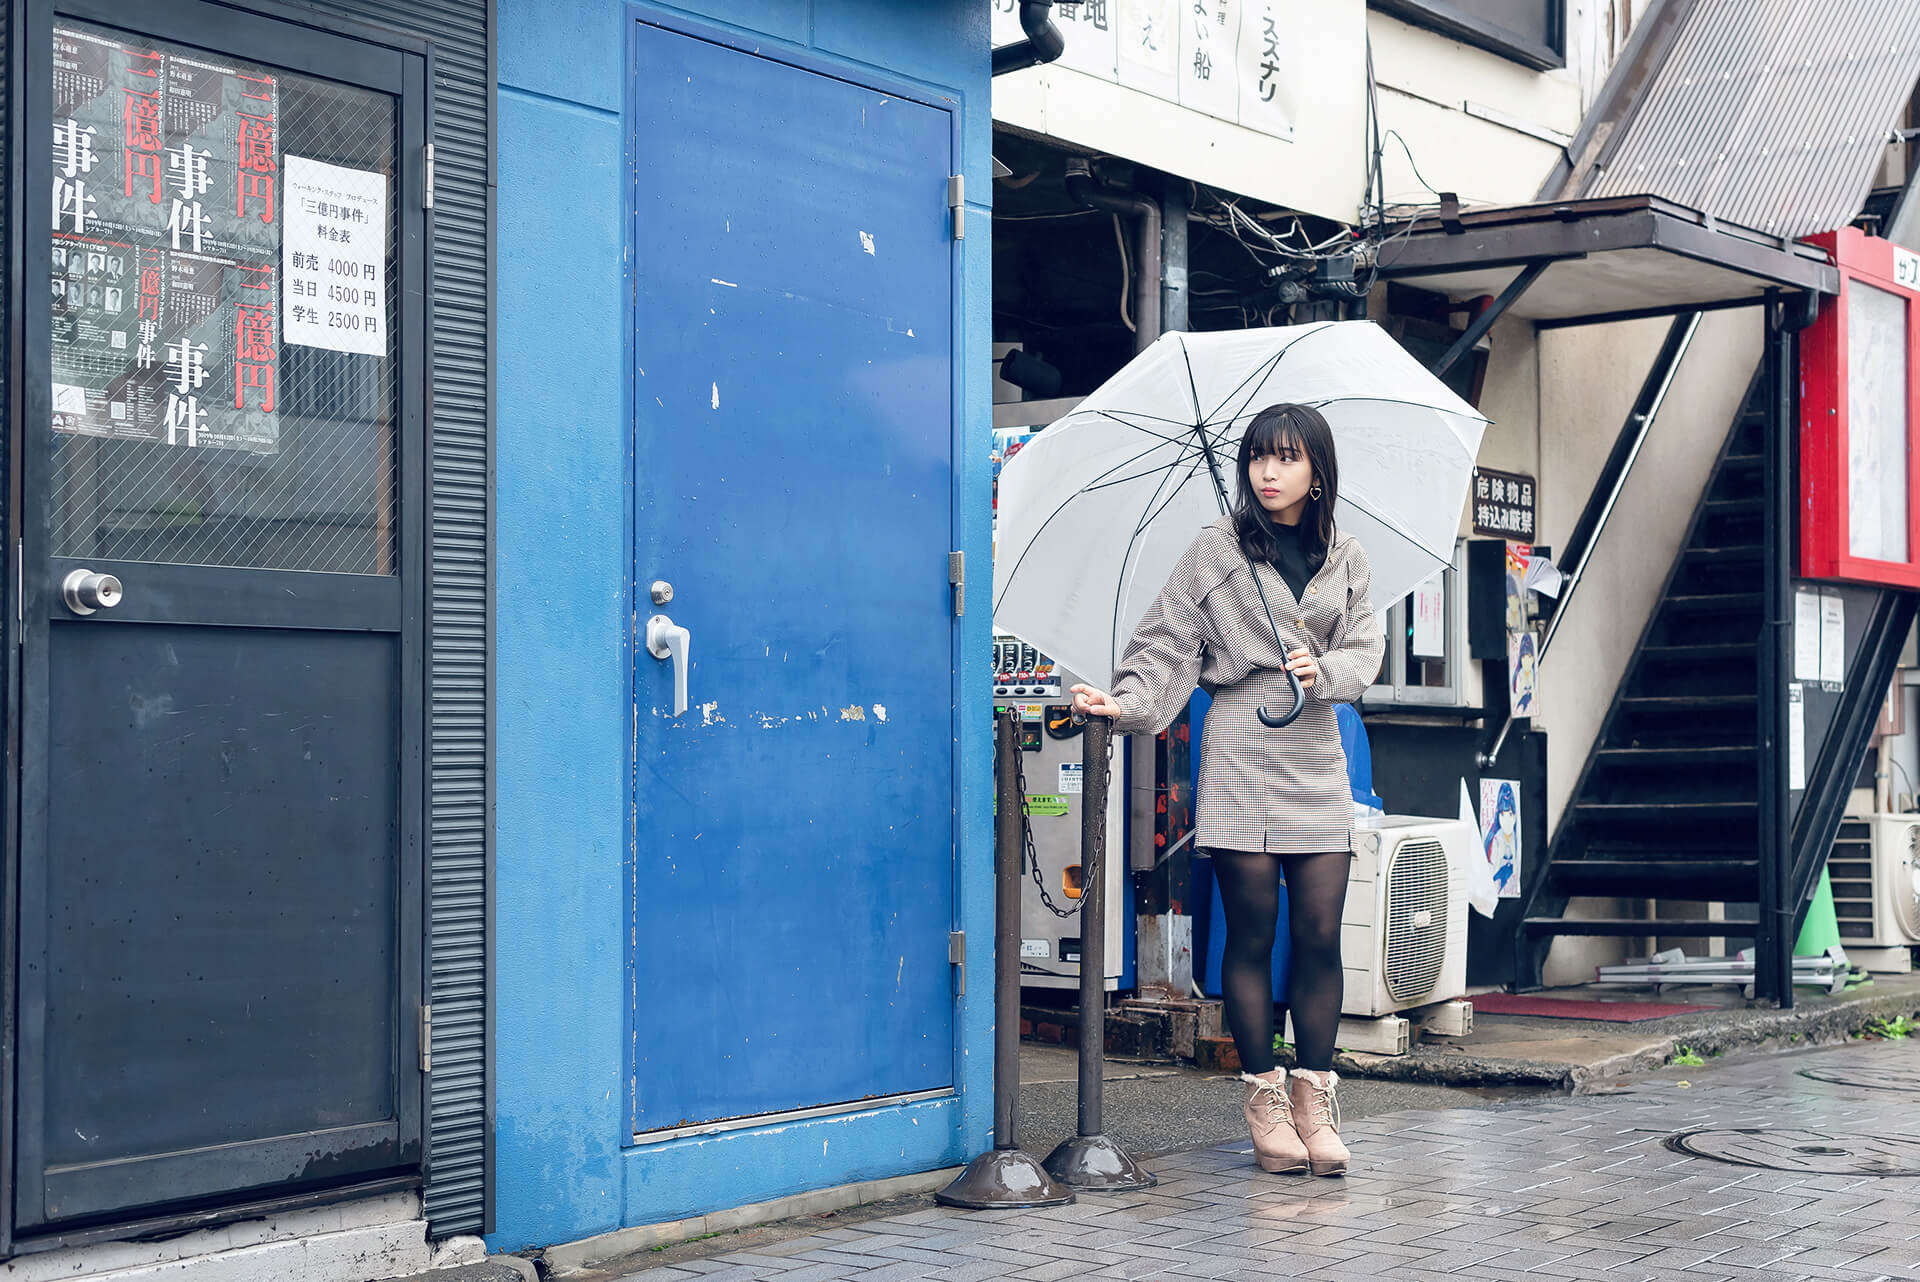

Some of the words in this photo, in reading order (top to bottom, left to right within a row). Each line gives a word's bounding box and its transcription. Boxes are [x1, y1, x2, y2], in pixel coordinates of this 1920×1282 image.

[121, 49, 162, 205] 三億円
[236, 74, 277, 224] 三億円
[52, 118, 99, 234] 事件
[165, 143, 215, 252] 事件
[300, 197, 369, 225] 「三億円事件」
[317, 224, 351, 244] 料金表
[291, 250, 319, 271] 前売
[327, 258, 358, 277] 4000
[363, 264, 376, 281] 円
[292, 278, 317, 297] 当日
[327, 284, 359, 304] 4500
[364, 290, 376, 307] 円
[292, 305, 319, 325] 学生
[328, 311, 360, 330] 2500
[365, 316, 377, 333] 円
[234, 264, 277, 413] 三億円
[163, 337, 211, 447] 事件
[1477, 476, 1532, 507] 危険物品
[1477, 503, 1532, 534] 持込み厳禁
